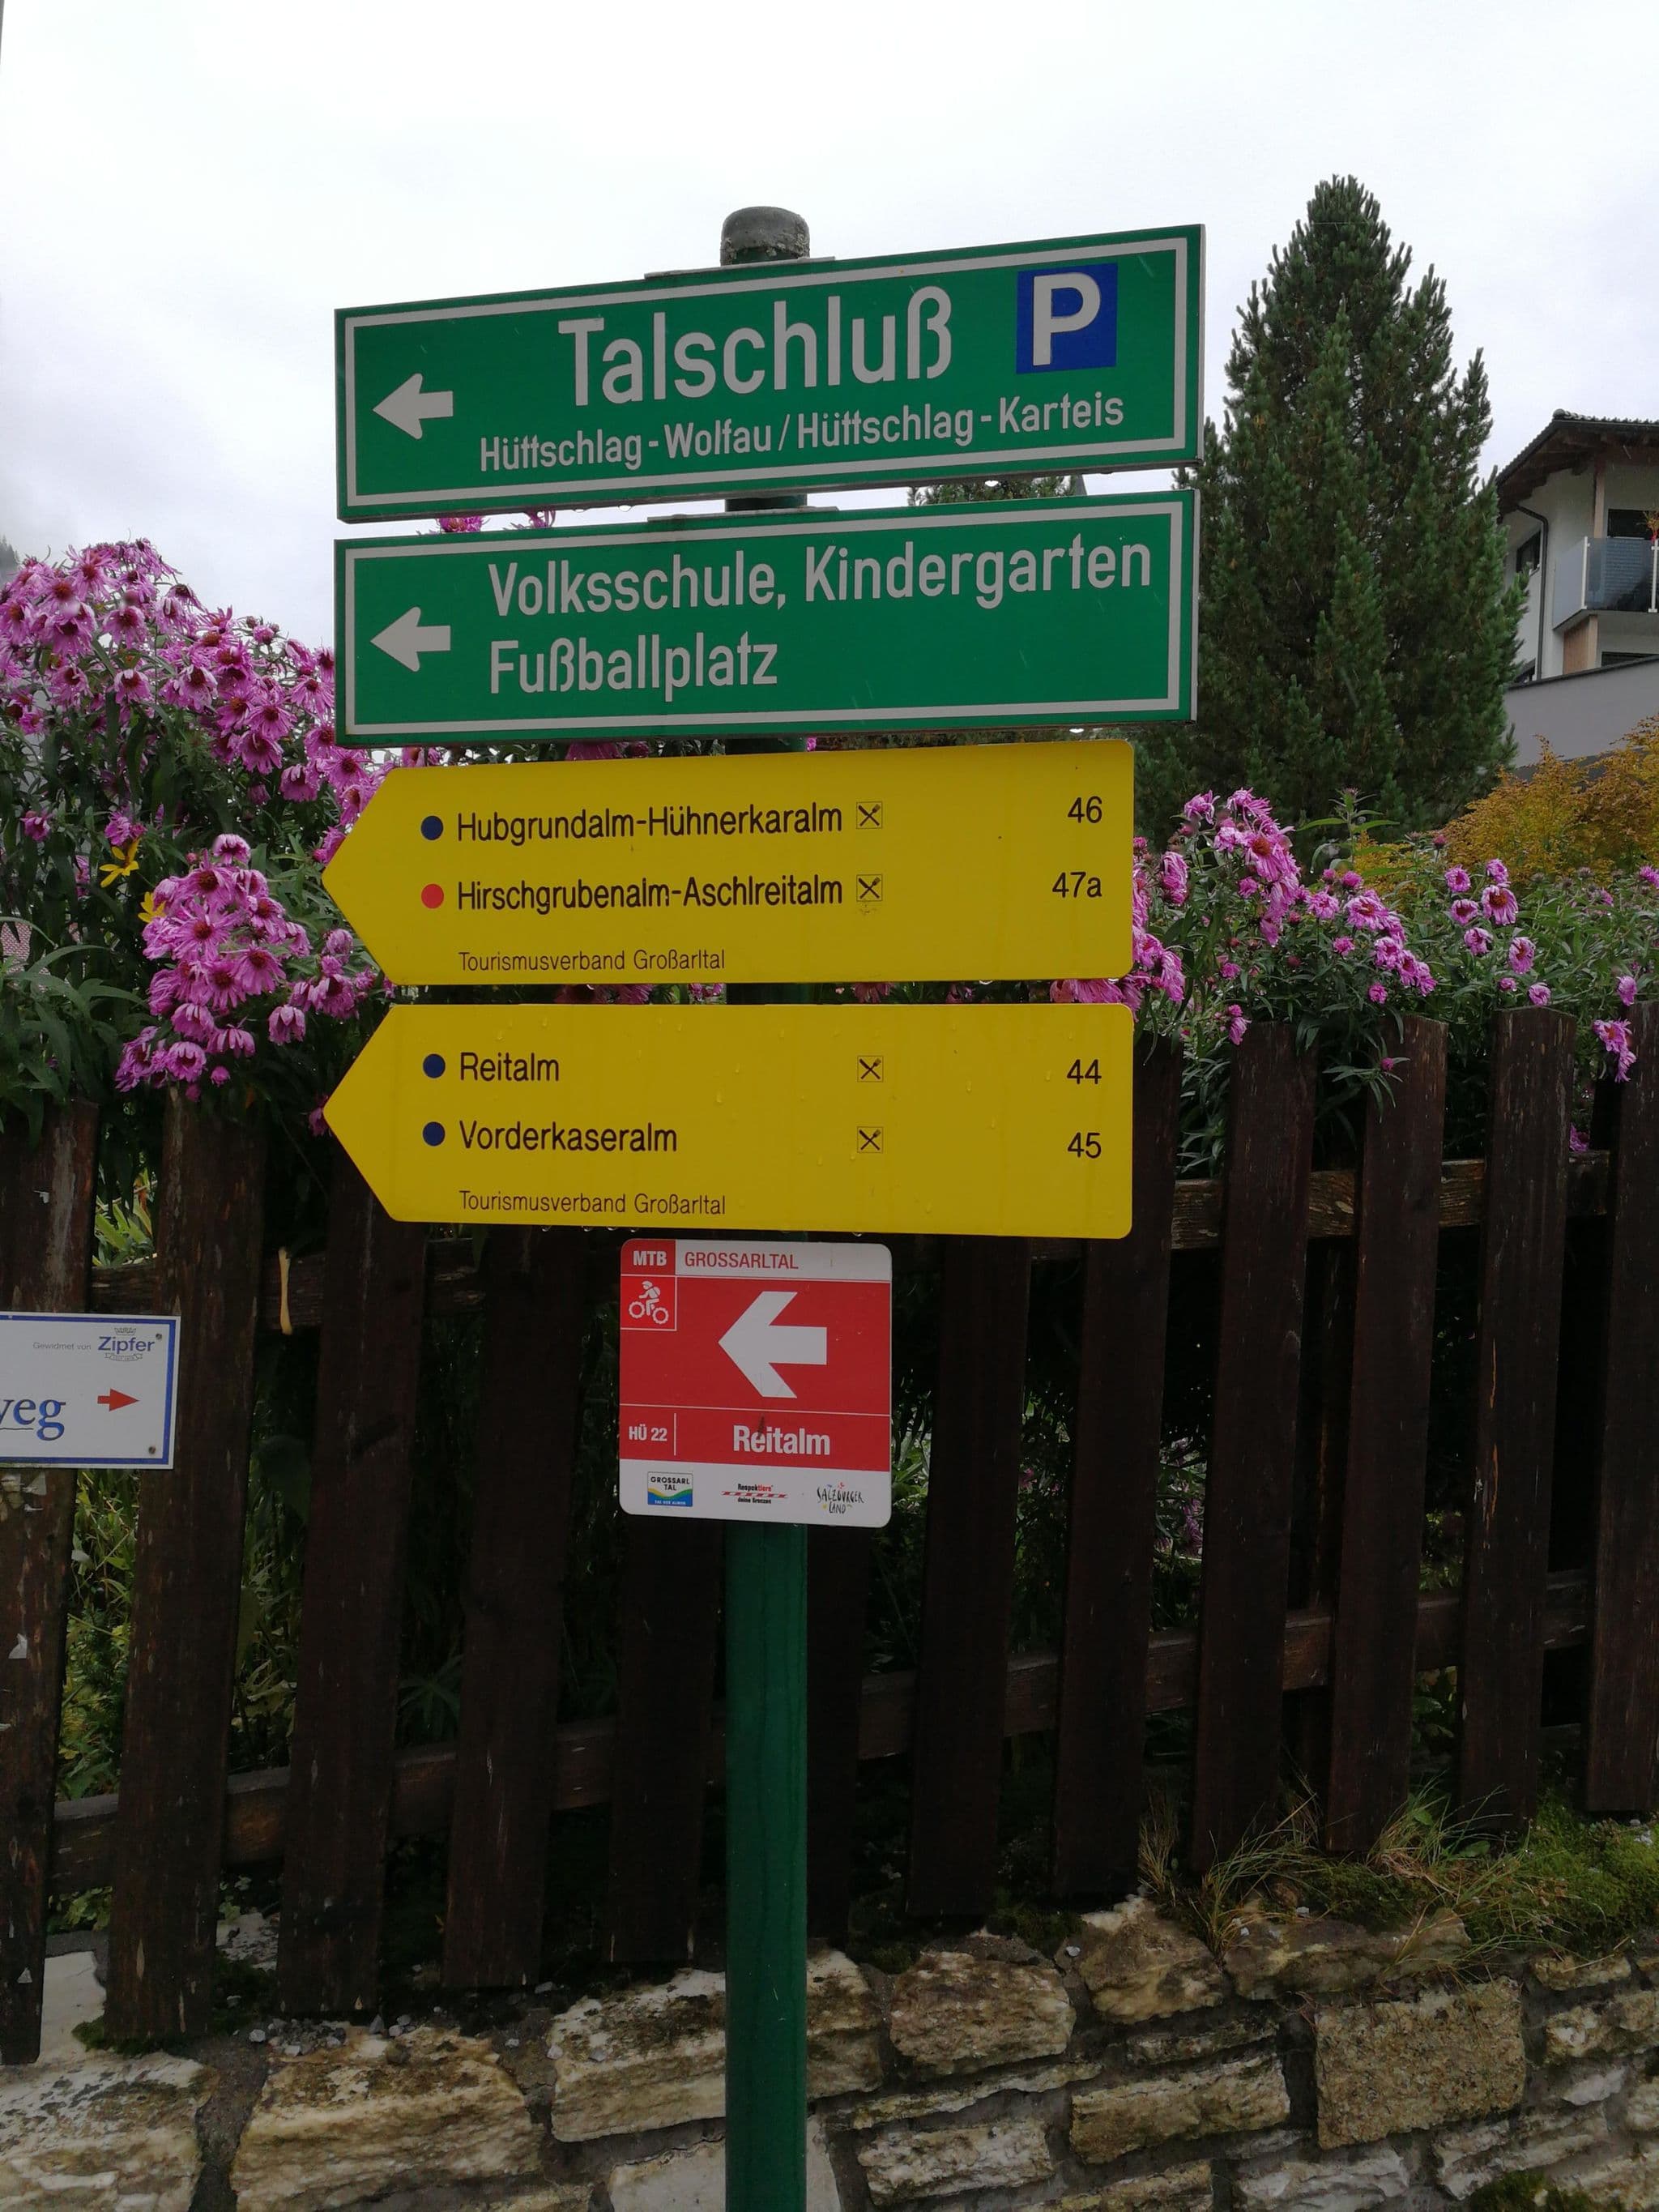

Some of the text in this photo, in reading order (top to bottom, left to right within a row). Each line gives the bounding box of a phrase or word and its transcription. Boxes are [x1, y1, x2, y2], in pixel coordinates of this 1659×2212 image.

[1031, 272, 1102, 366] P
[557, 285, 953, 408] Talschluß
[488, 533, 1152, 617] Volksschule, Kindergarten
[490, 631, 778, 702] Fußballplatz
[458, 796, 1102, 847] Hubgrundalm-Hühnerkaralm 46
[458, 871, 1102, 916] Hirschgrubenalm-Aschlreitalm 47a
[458, 948, 725, 971] Tourismusverband Großarltal
[459, 1052, 1102, 1086] Reitalm 44
[458, 1120, 1102, 1160] Vorderkaseralm 45
[458, 1190, 726, 1215] Tourismusverband Großarltal
[633, 1249, 668, 1267] MTB
[684, 1251, 799, 1270] GROSSARLTAL
[98, 1336, 156, 1355] Zipfer
[629, 1424, 667, 1442] HÜ 22
[733, 1424, 831, 1456] Reitalm
[650, 1476, 690, 1484] GROSSARL
